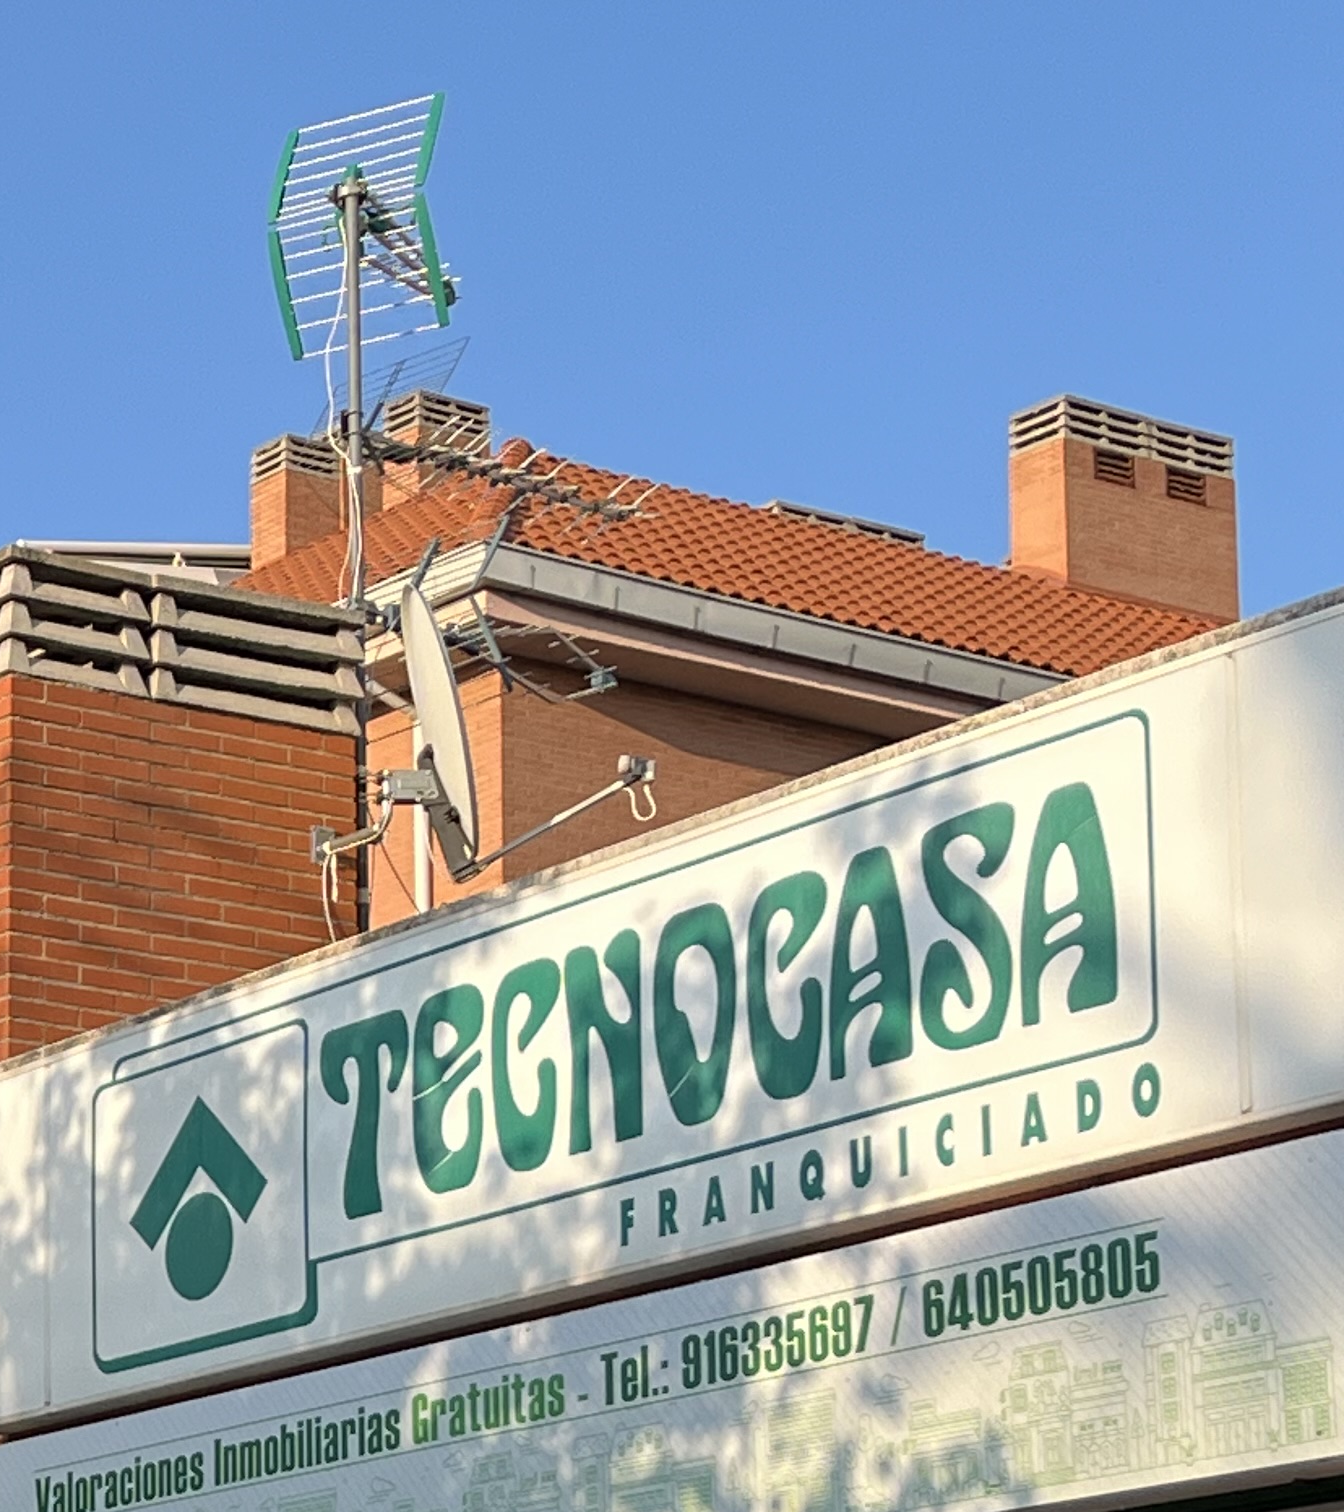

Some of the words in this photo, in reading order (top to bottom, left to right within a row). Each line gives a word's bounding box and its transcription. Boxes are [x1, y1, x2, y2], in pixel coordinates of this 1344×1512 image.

[619, 1062, 1162, 1247] FRANQUICIADO
[214, 1406, 401, 1486] Inmobiliarias
[411, 1372, 565, 1445] Gratuitas
[600, 1345, 670, 1404] Tel.:
[681, 1295, 874, 1388] 916335697
[922, 1231, 1160, 1337] 640505805
